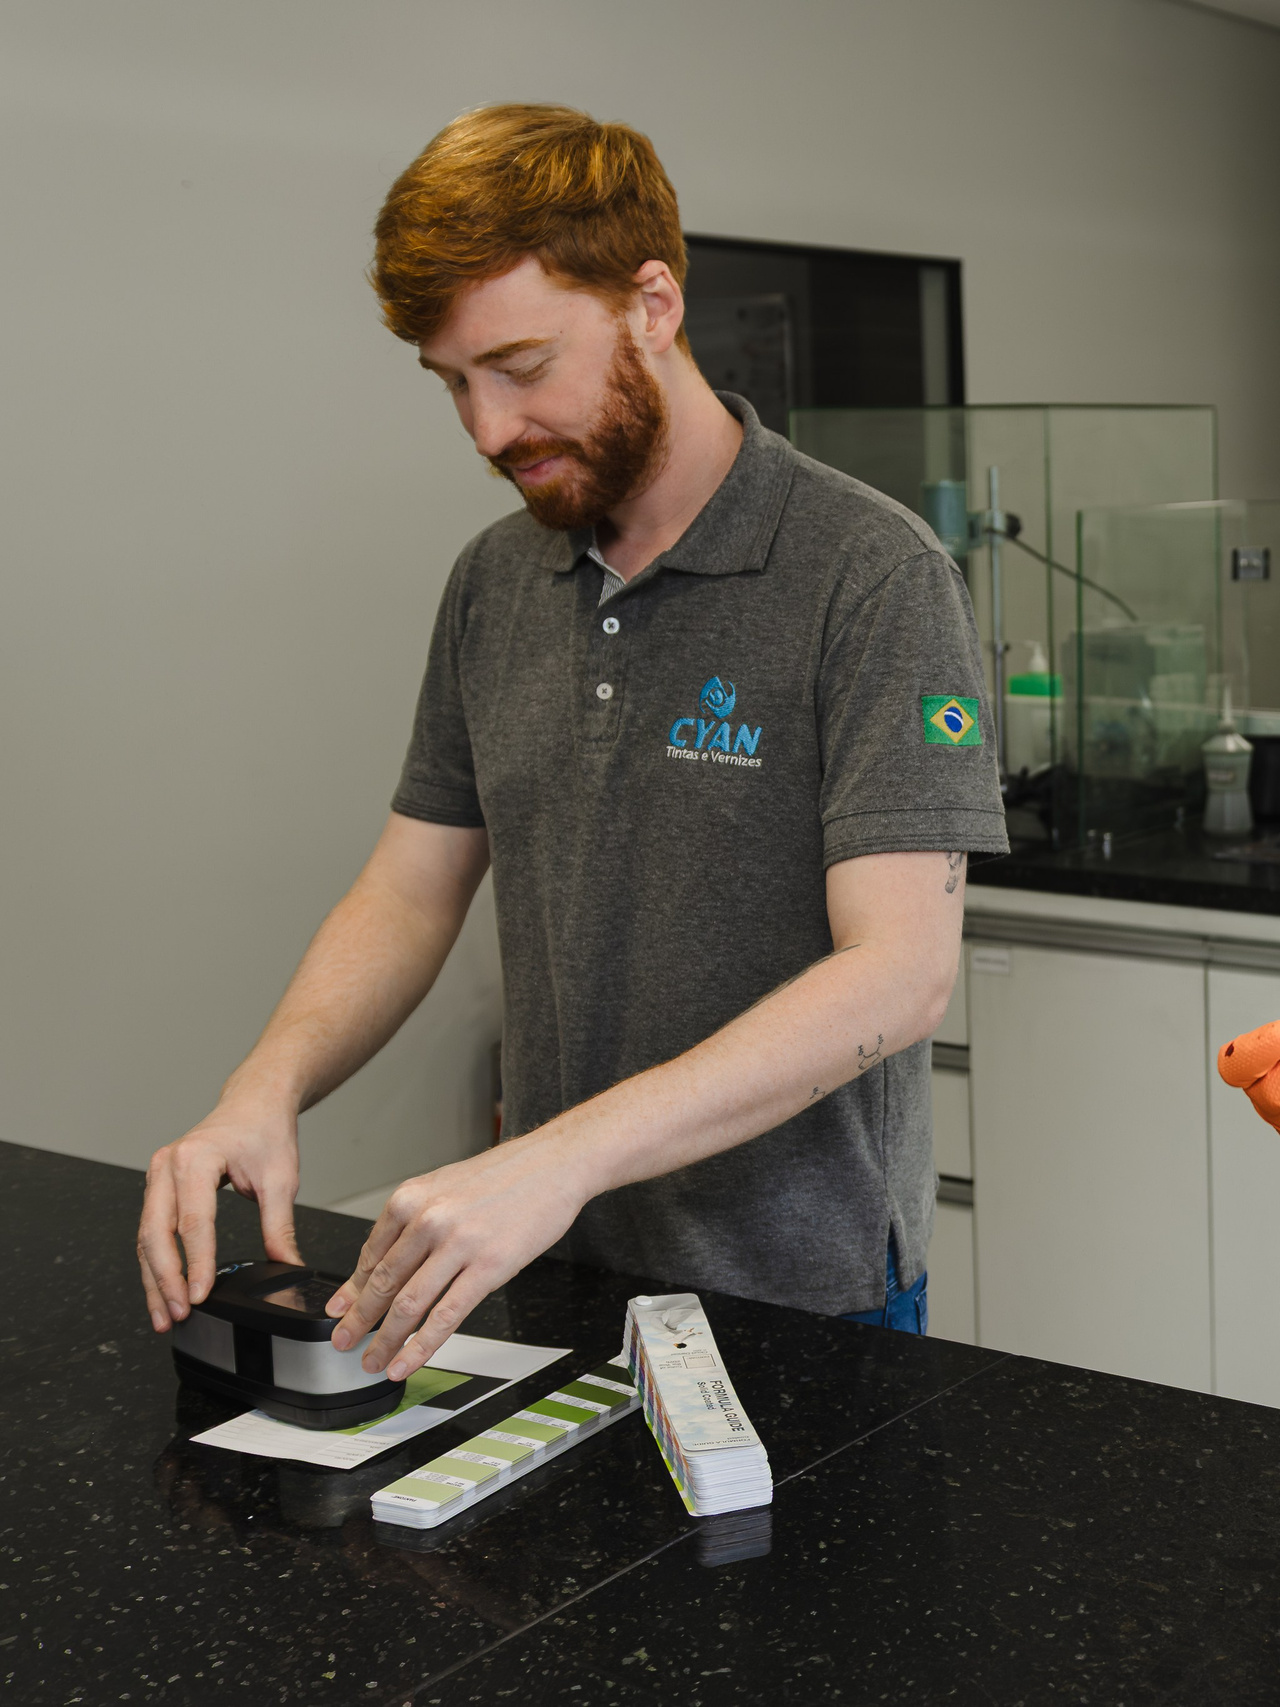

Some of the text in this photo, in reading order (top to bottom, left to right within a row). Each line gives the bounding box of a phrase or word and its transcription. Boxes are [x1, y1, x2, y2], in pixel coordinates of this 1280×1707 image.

[669, 717, 763, 756] CYAN
[666, 745, 762, 767] Tintas e Vernizes
[697, 1381, 710, 1394] Solid
[709, 1380, 735, 1412] FORMULA
[724, 1412, 745, 1432] GUIDE
